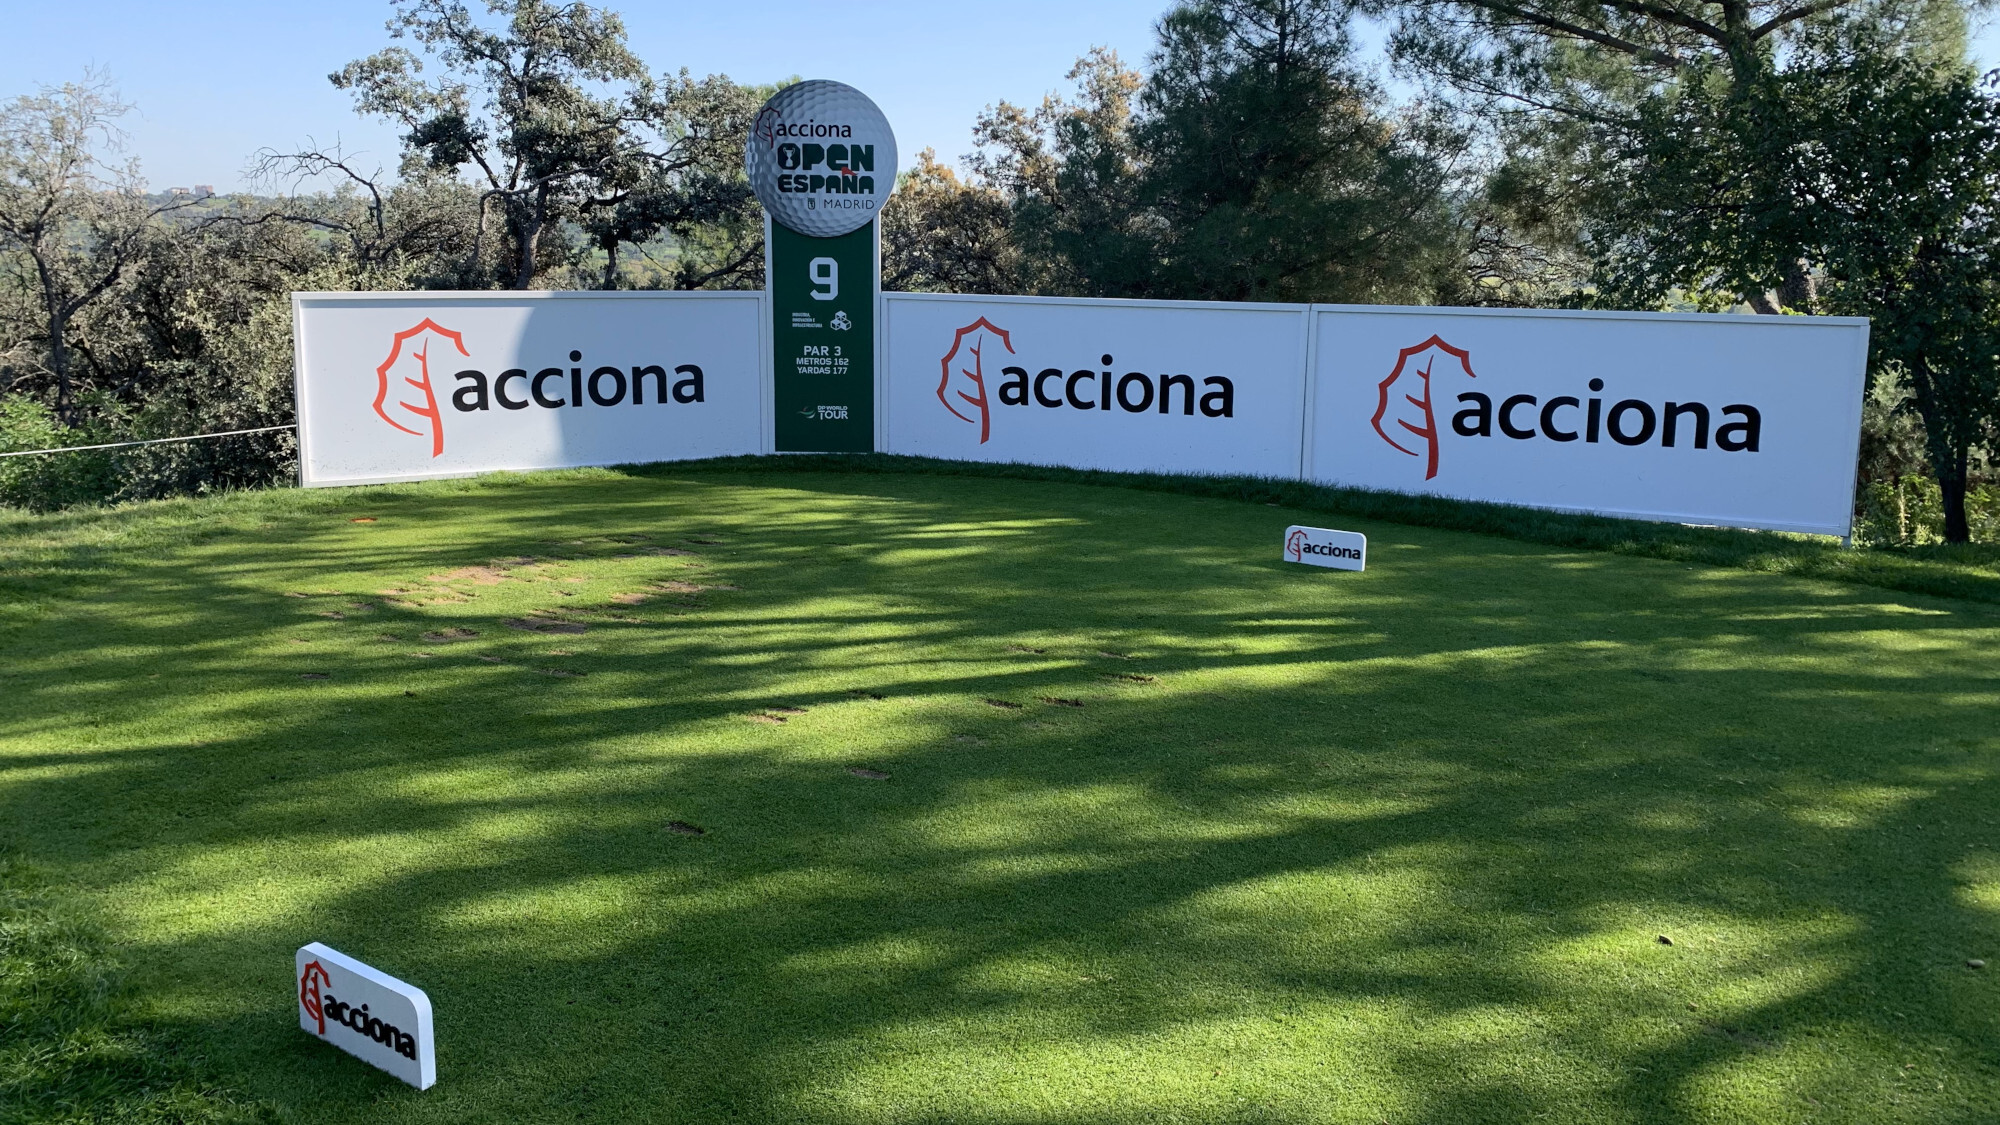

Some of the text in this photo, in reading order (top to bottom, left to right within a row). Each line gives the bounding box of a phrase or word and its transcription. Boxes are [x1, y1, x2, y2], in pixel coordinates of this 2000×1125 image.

[776, 119, 852, 138] acciona
[777, 143, 874, 172] OPEN
[823, 199, 875, 210] MADRID
[809, 256, 839, 300] 9
[803, 345, 841, 356] PAR 3
[796, 357, 849, 366] METROS 162
[797, 366, 848, 375] YARDAS 177
[452, 349, 705, 412] acciona
[998, 353, 1234, 418] acciona
[817, 410, 849, 420] TOUR
[1451, 378, 1761, 453] acciona
[1302, 542, 1361, 560] acciona
[323, 994, 417, 1061] acciona
